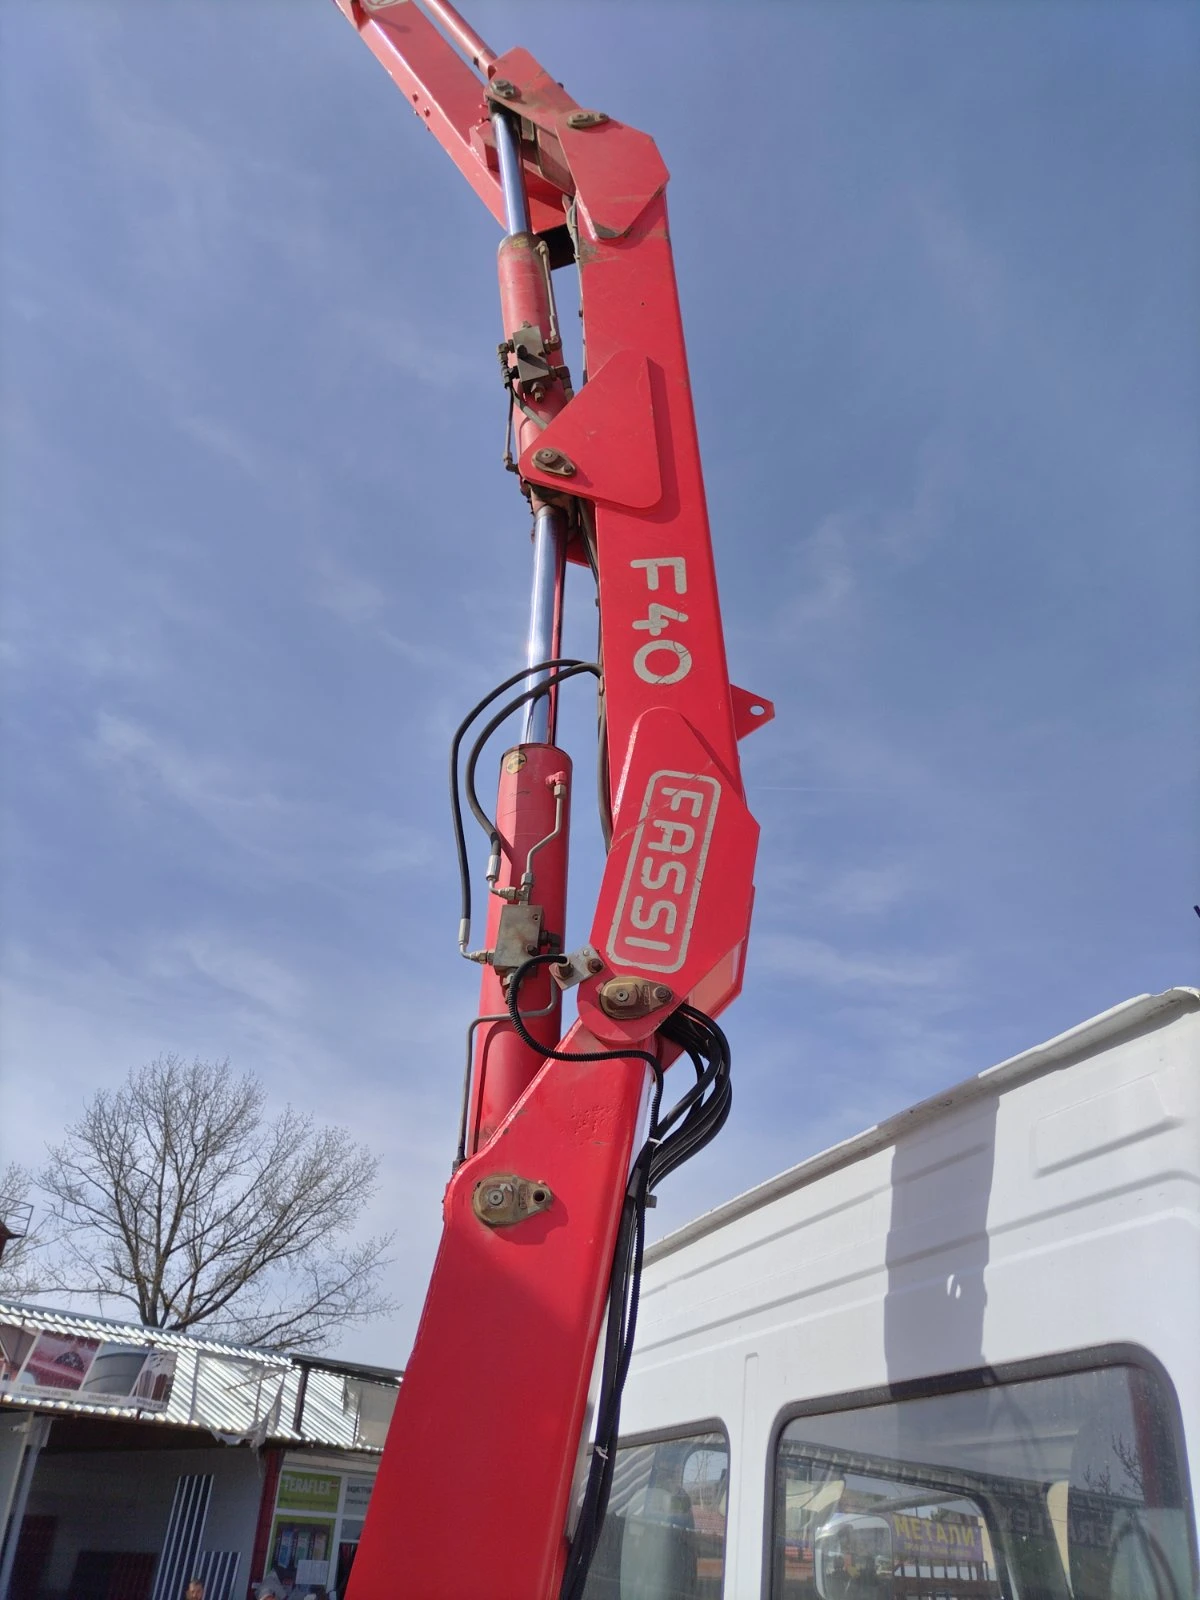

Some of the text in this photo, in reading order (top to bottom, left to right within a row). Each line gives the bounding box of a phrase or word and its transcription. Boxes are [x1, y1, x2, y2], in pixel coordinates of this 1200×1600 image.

[630, 556, 692, 685] F40
[625, 788, 703, 950] FASSI
[894, 1516, 974, 1546] МЕТАЛИ
